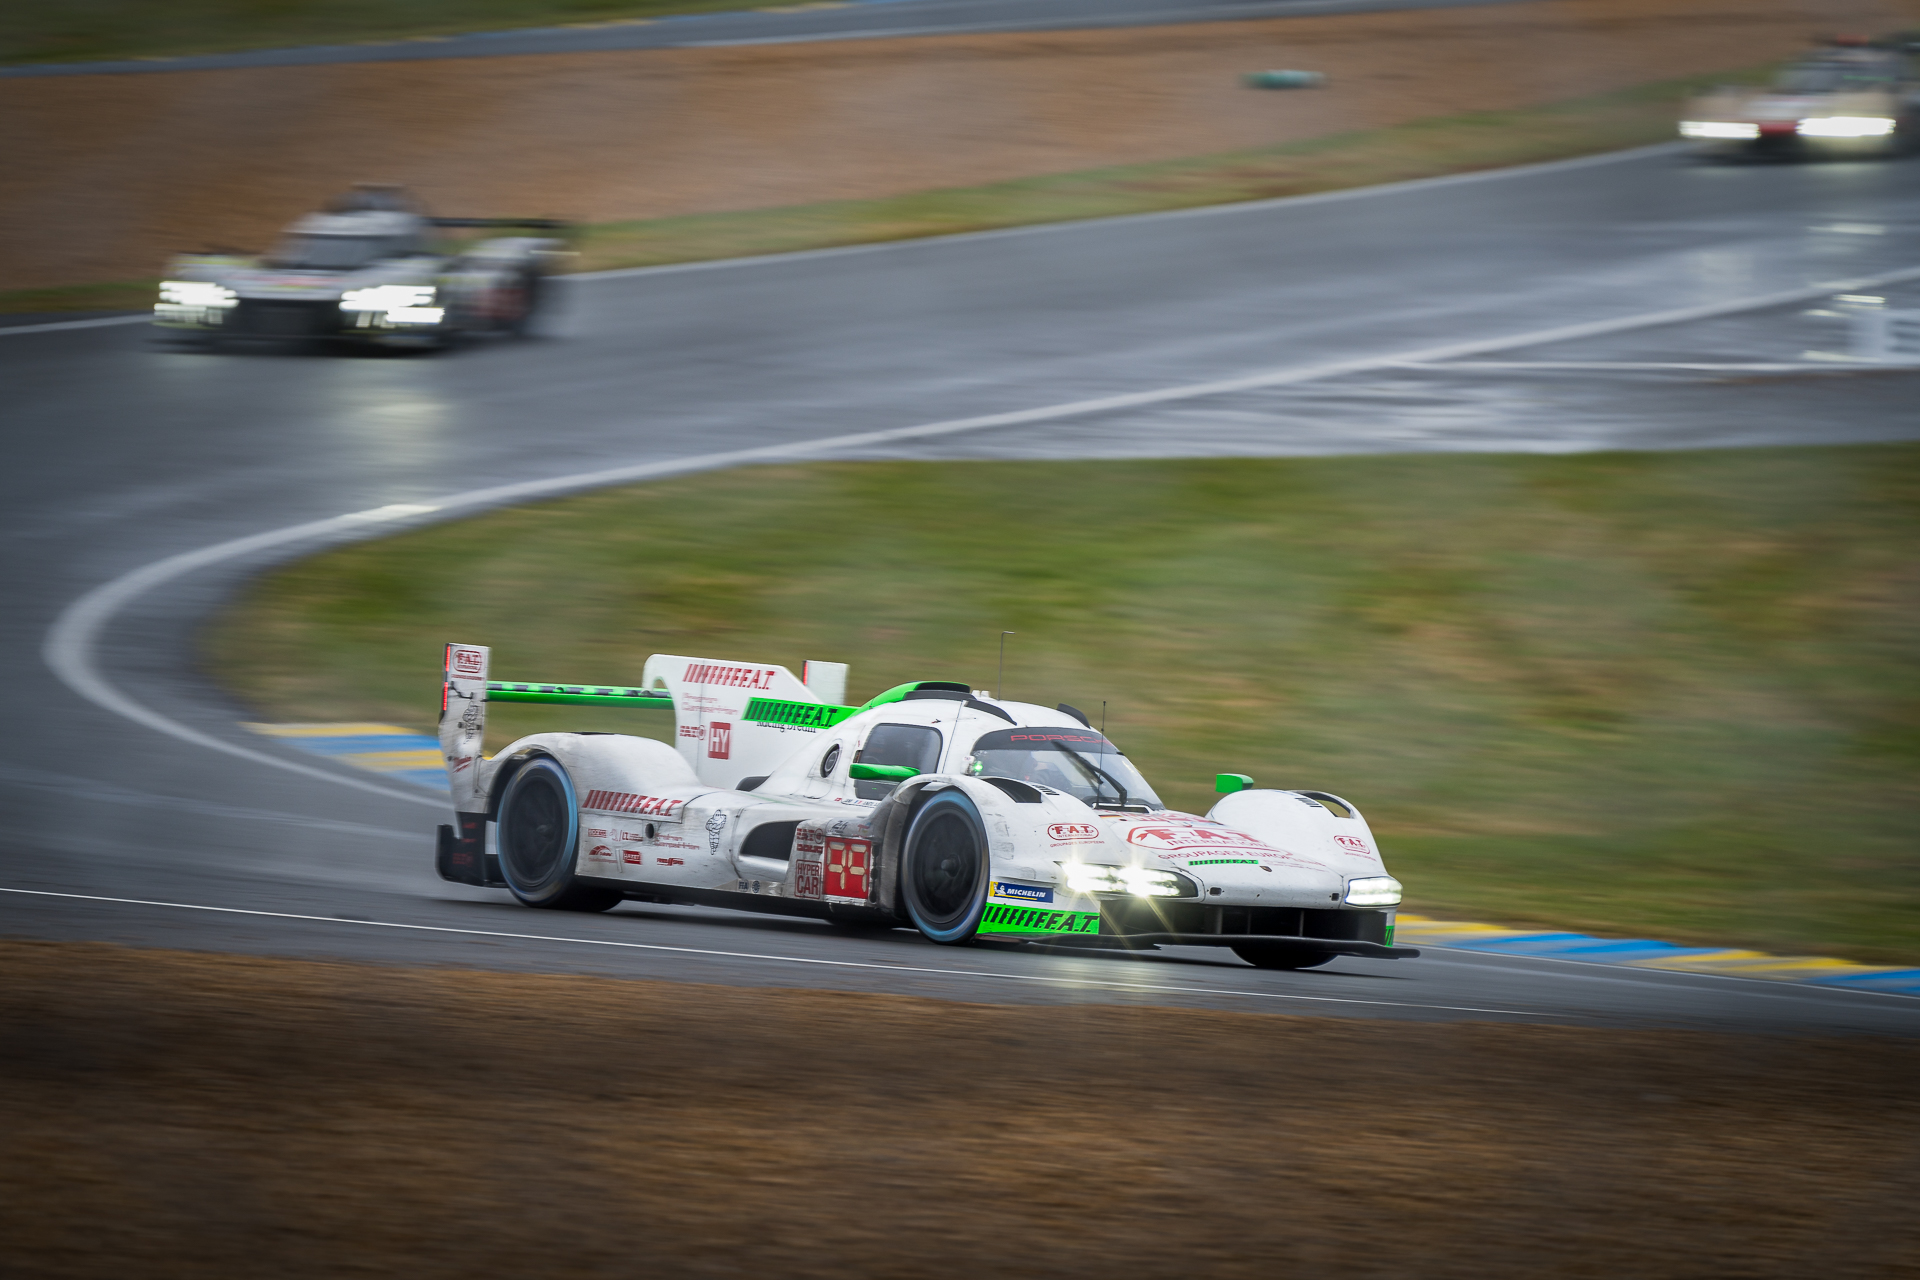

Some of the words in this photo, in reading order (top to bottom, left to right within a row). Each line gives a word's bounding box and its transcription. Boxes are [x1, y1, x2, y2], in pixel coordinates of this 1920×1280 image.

[710, 728, 730, 753] HY
[797, 862, 819, 876] HYPER
[827, 841, 868, 892] 99
[797, 875, 819, 895] CAR
[1006, 888, 1046, 898] MICHELIN
